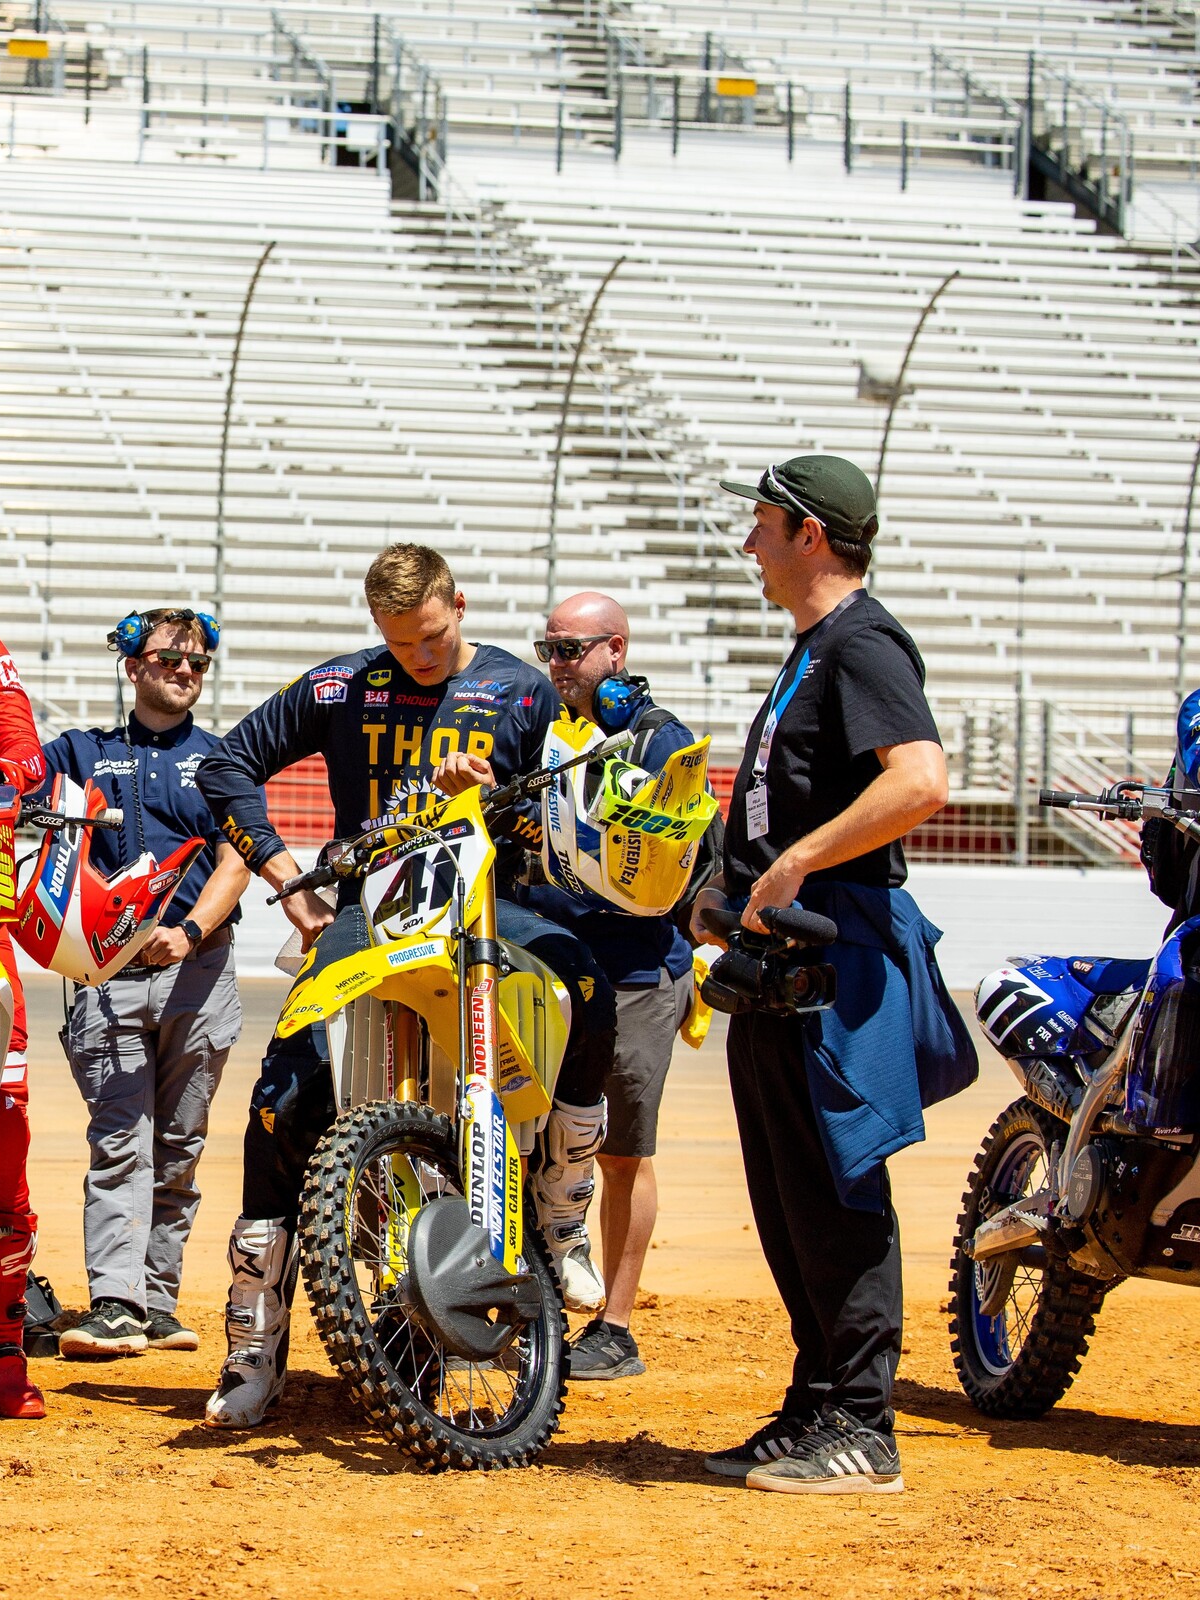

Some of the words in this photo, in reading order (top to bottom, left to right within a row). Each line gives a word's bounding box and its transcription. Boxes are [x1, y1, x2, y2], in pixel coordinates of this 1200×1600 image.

[310, 666, 353, 676] PARTS
[319, 685, 342, 698] 100%
[394, 694, 439, 707] SHOWA
[454, 692, 495, 701] NOLEEN
[362, 724, 494, 767] THOR
[175, 760, 201, 771] TWIST
[527, 773, 552, 788] ARC
[32, 815, 64, 826] ARC
[608, 803, 693, 841] 100%
[222, 815, 258, 861] THO
[626, 829, 641, 865] ISTED
[49, 846, 72, 899] THOR
[558, 850, 583, 894] THOR
[619, 865, 639, 886] TEA
[373, 842, 462, 927] 41
[113, 903, 136, 938] TWISTED
[401, 917, 425, 932] SKDA
[102, 933, 120, 949] TEA
[388, 943, 437, 966] PROGRESSIVE
[335, 970, 368, 990] MAYHEM
[978, 979, 1047, 1039] 11
[472, 996, 487, 1077] NOLEEN
[1036, 1025, 1052, 1042] FXR
[500, 1056, 516, 1068] TRIG
[1004, 1119, 1033, 1140] DUNLOP
[1154, 1127, 1171, 1135] Twin
[1171, 1126, 1182, 1134] Air
[491, 1113, 505, 1190] ECSTAR
[470, 1122, 487, 1227] DUNLOP
[509, 1156, 519, 1214] GALFER
[508, 1219, 518, 1249] SKDA
